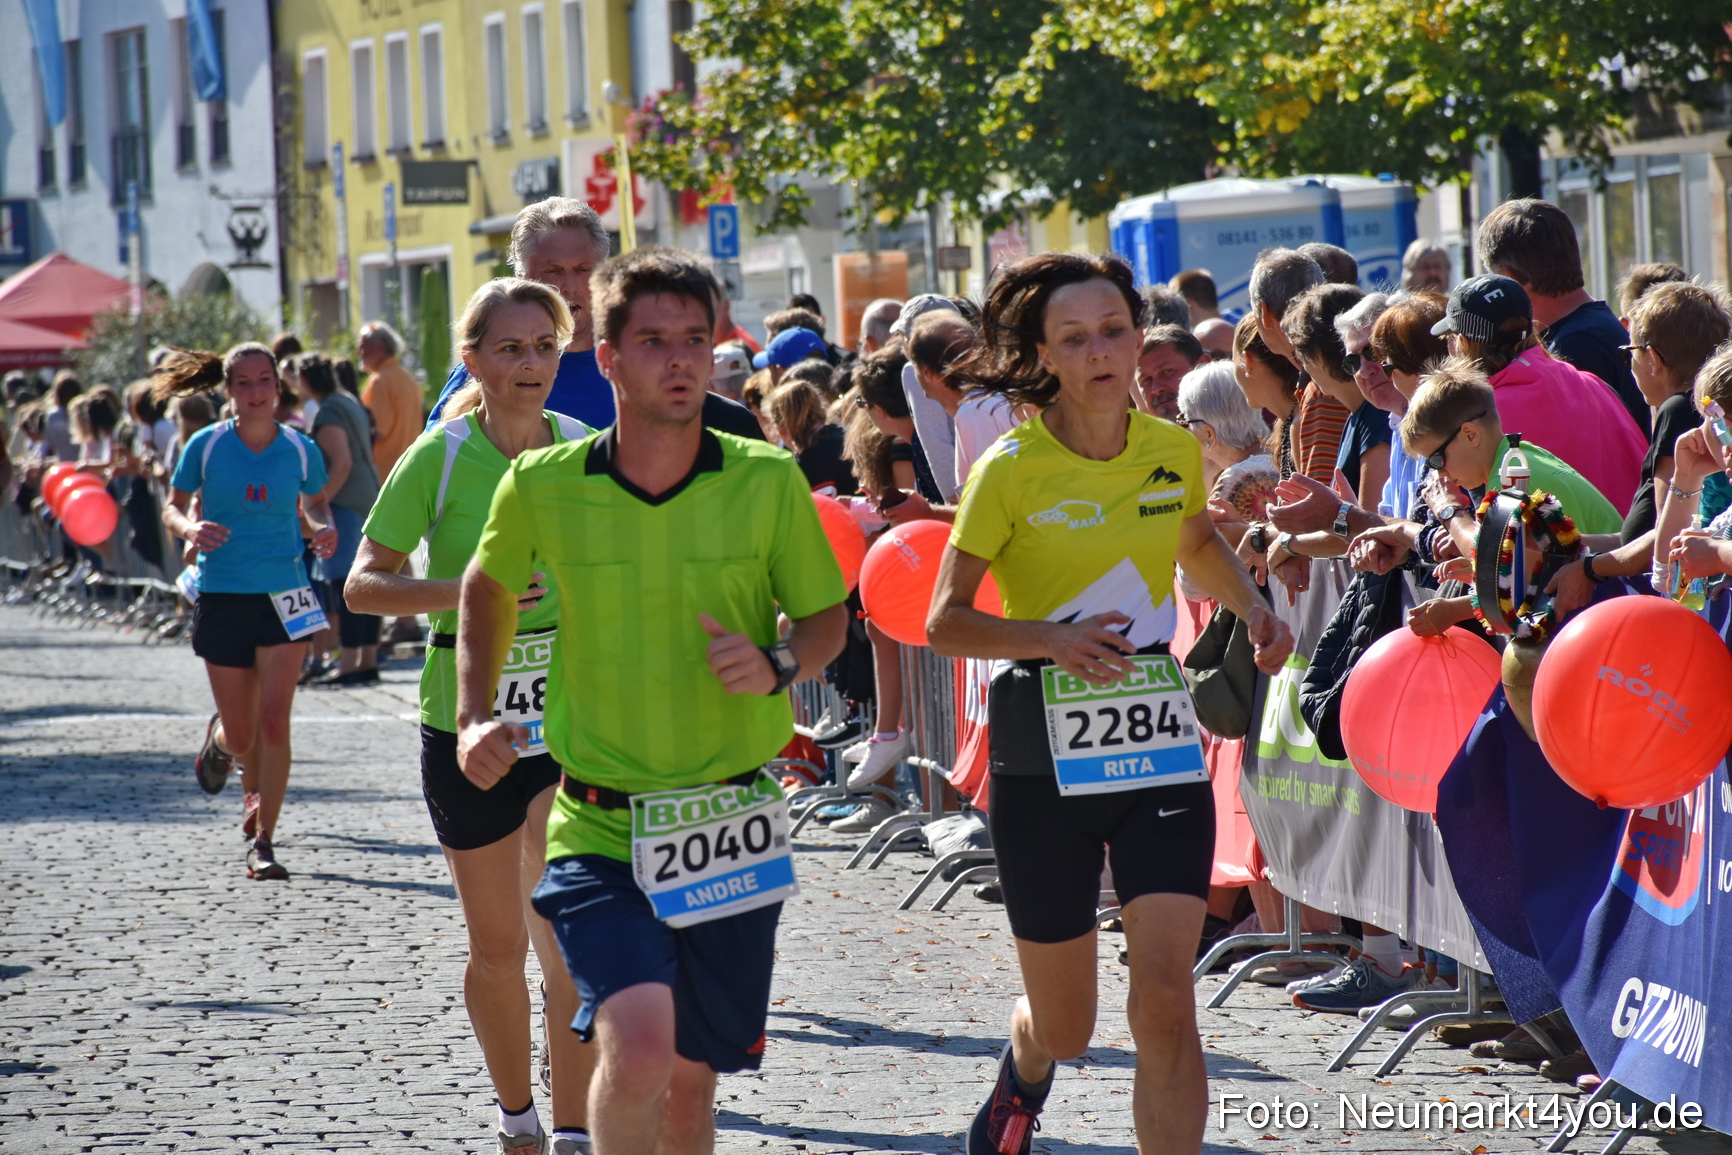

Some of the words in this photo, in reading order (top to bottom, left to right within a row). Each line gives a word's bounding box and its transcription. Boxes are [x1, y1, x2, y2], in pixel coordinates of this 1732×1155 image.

[1217, 231, 1257, 246] 08141
[1269, 228, 1293, 241] 536
[1068, 515, 1106, 530] MARX
[1139, 501, 1183, 517] Runners
[1597, 663, 1693, 728] RÖDL
[1065, 701, 1181, 750] 2284
[1104, 757, 1155, 778] RITA
[1294, 770, 1306, 811] by
[1309, 781, 1342, 809] smart
[654, 814, 771, 883] 2040
[684, 872, 759, 908] ANDRE
